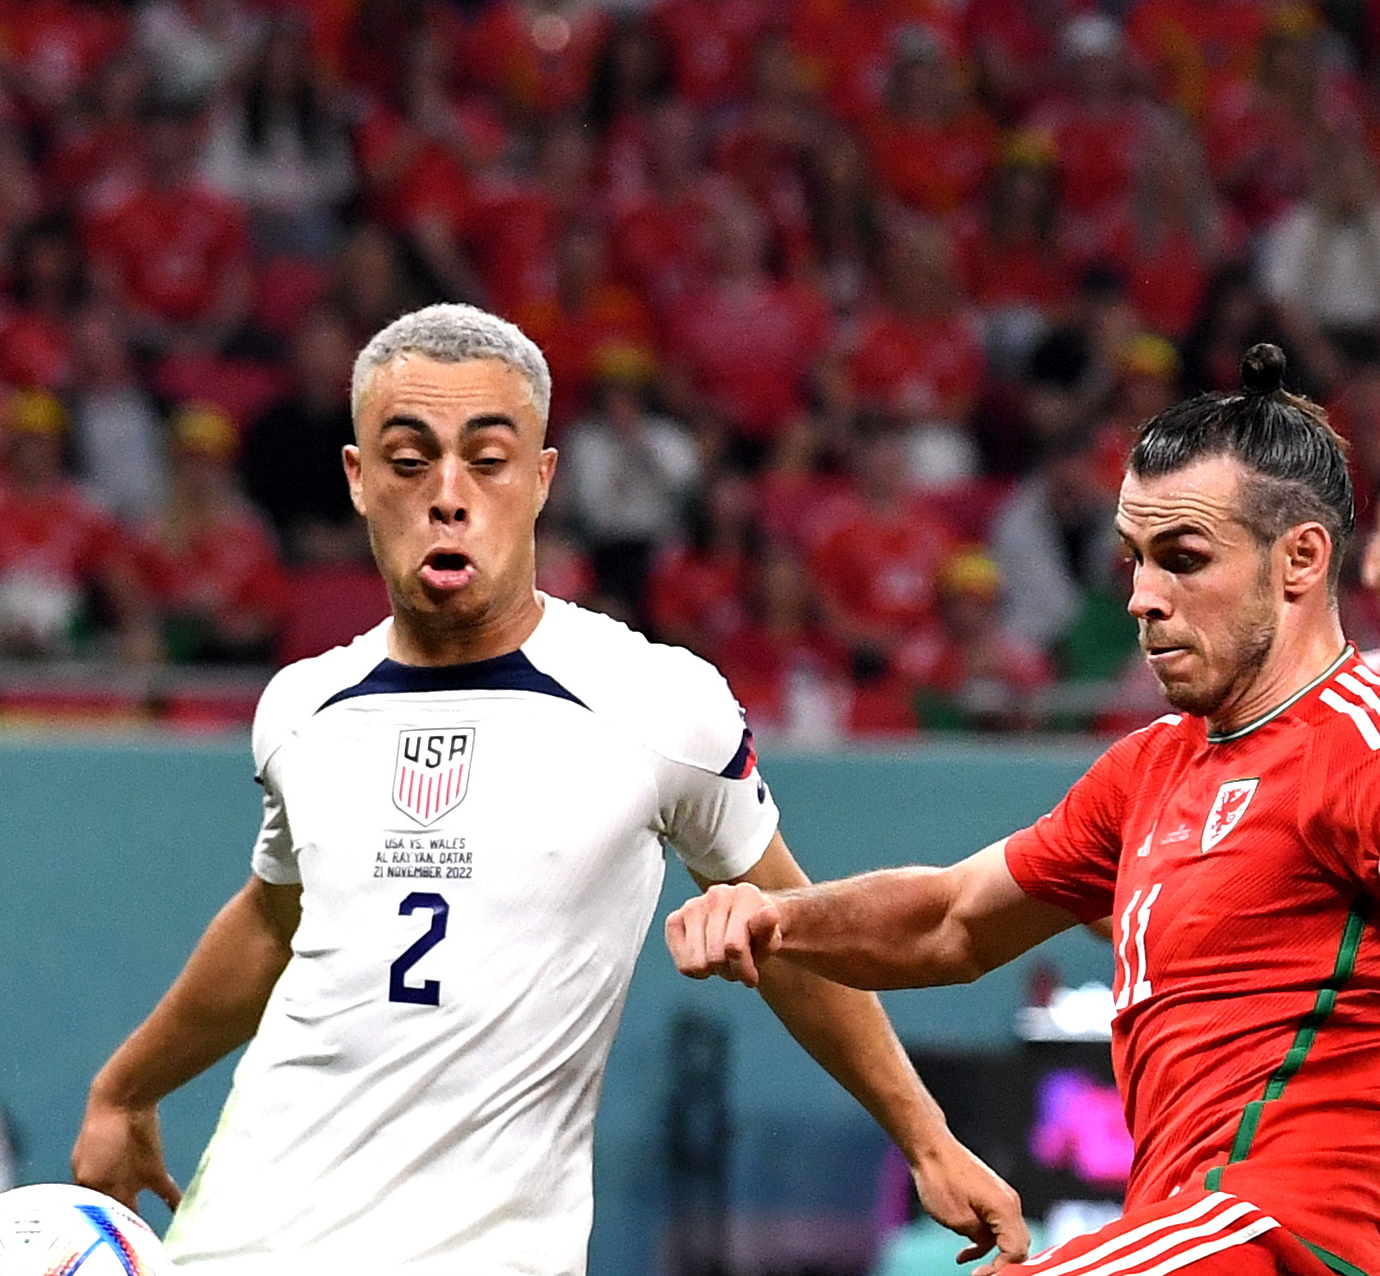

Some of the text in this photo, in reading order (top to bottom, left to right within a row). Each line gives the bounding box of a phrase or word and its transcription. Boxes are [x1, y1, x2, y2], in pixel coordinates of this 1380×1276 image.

[404, 735, 468, 769] USA
[384, 838, 406, 850] USA
[429, 837, 467, 850] WALES
[375, 851, 389, 864] AL
[439, 851, 473, 865] QATAR
[373, 865, 473, 879] 21 NOVEMBER 2022
[388, 892, 450, 1006] 2
[1116, 883, 1163, 1010] 11
